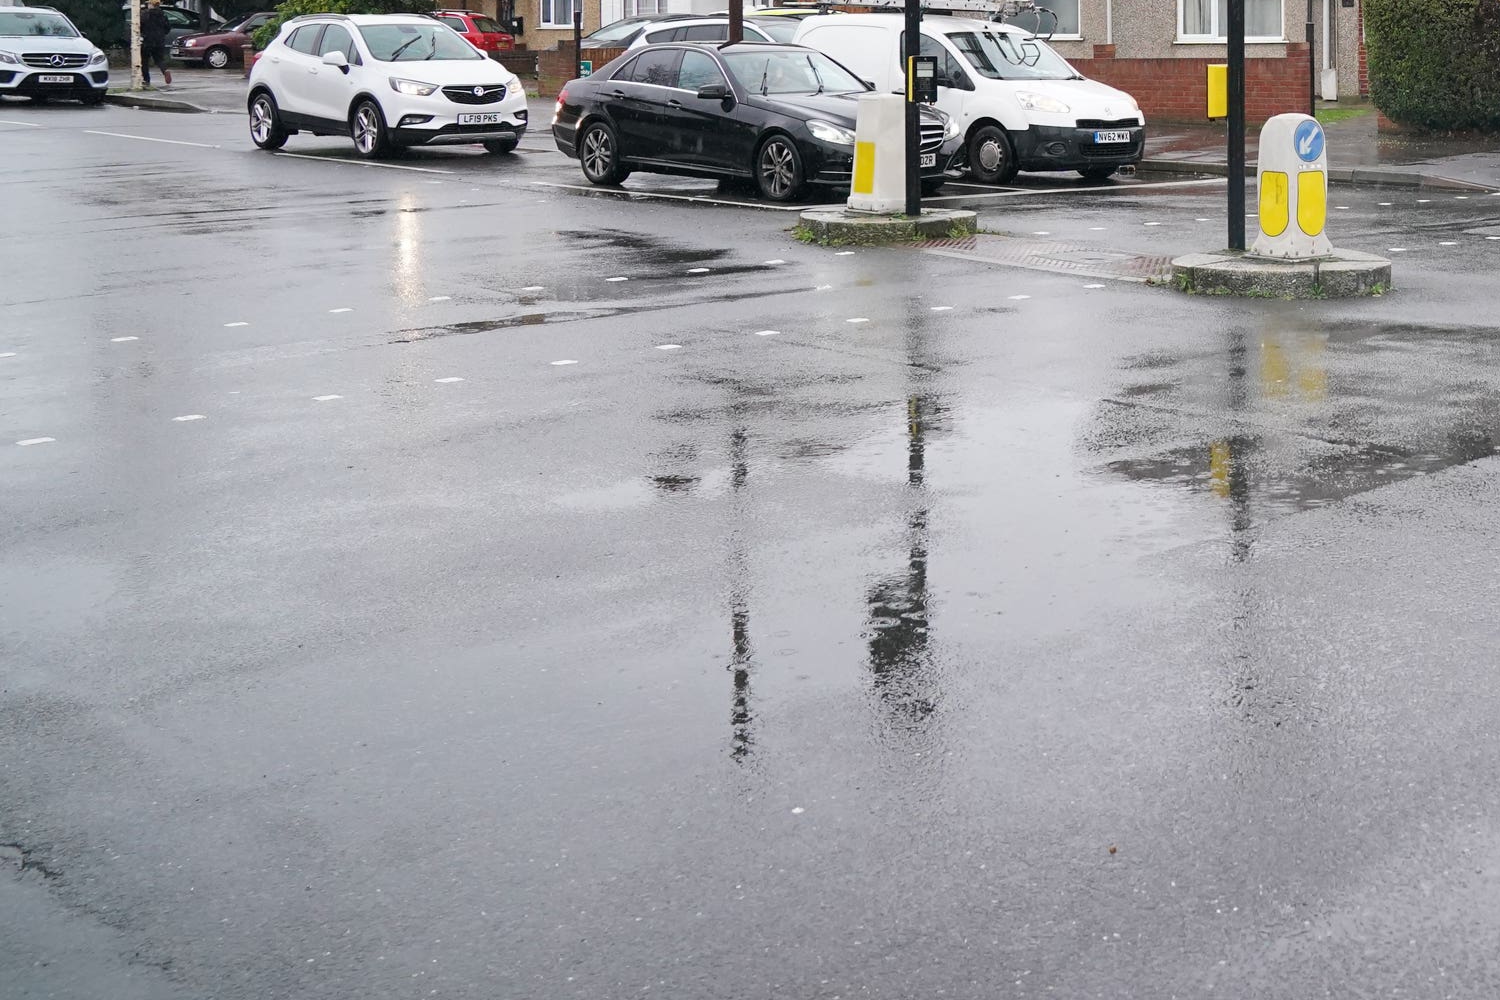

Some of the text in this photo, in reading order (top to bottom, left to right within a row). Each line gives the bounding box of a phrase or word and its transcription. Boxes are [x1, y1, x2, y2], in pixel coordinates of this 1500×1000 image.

[463, 114, 498, 123] LF19 PKS
[1099, 132, 1116, 141] NV62
